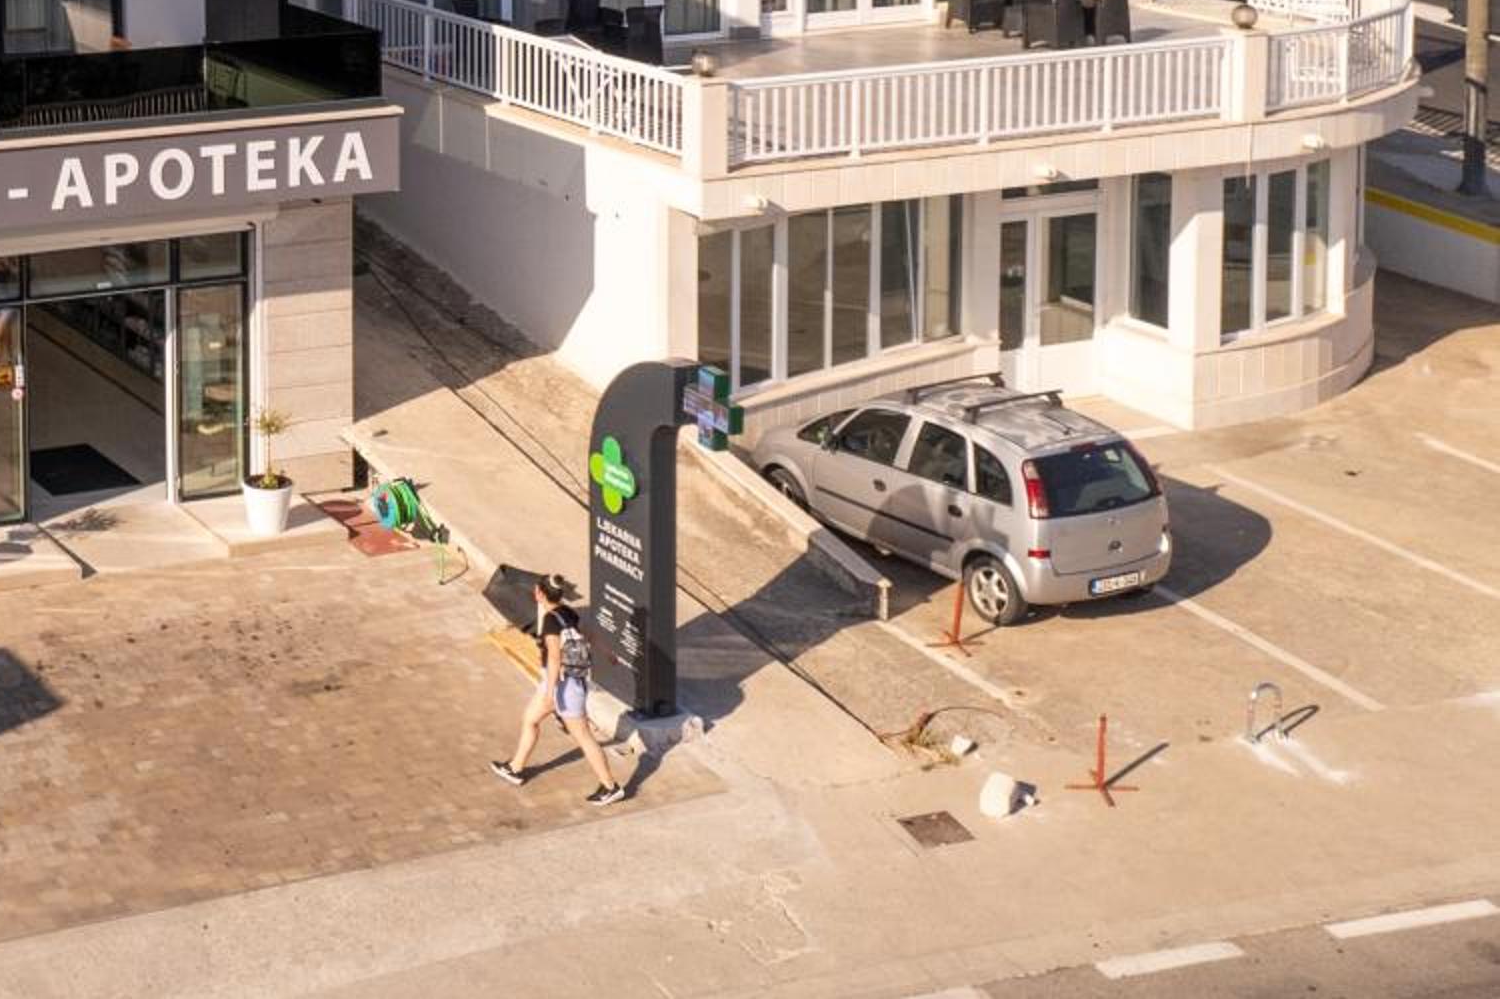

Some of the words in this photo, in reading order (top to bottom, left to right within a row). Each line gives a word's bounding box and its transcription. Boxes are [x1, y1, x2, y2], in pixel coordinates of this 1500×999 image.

[7, 188, 29, 200] -
[51, 131, 373, 210] APOTEKA
[596, 516, 642, 551] LJEKARNA
[599, 532, 640, 565] APOTEKA
[595, 544, 644, 582] PHARMACY
